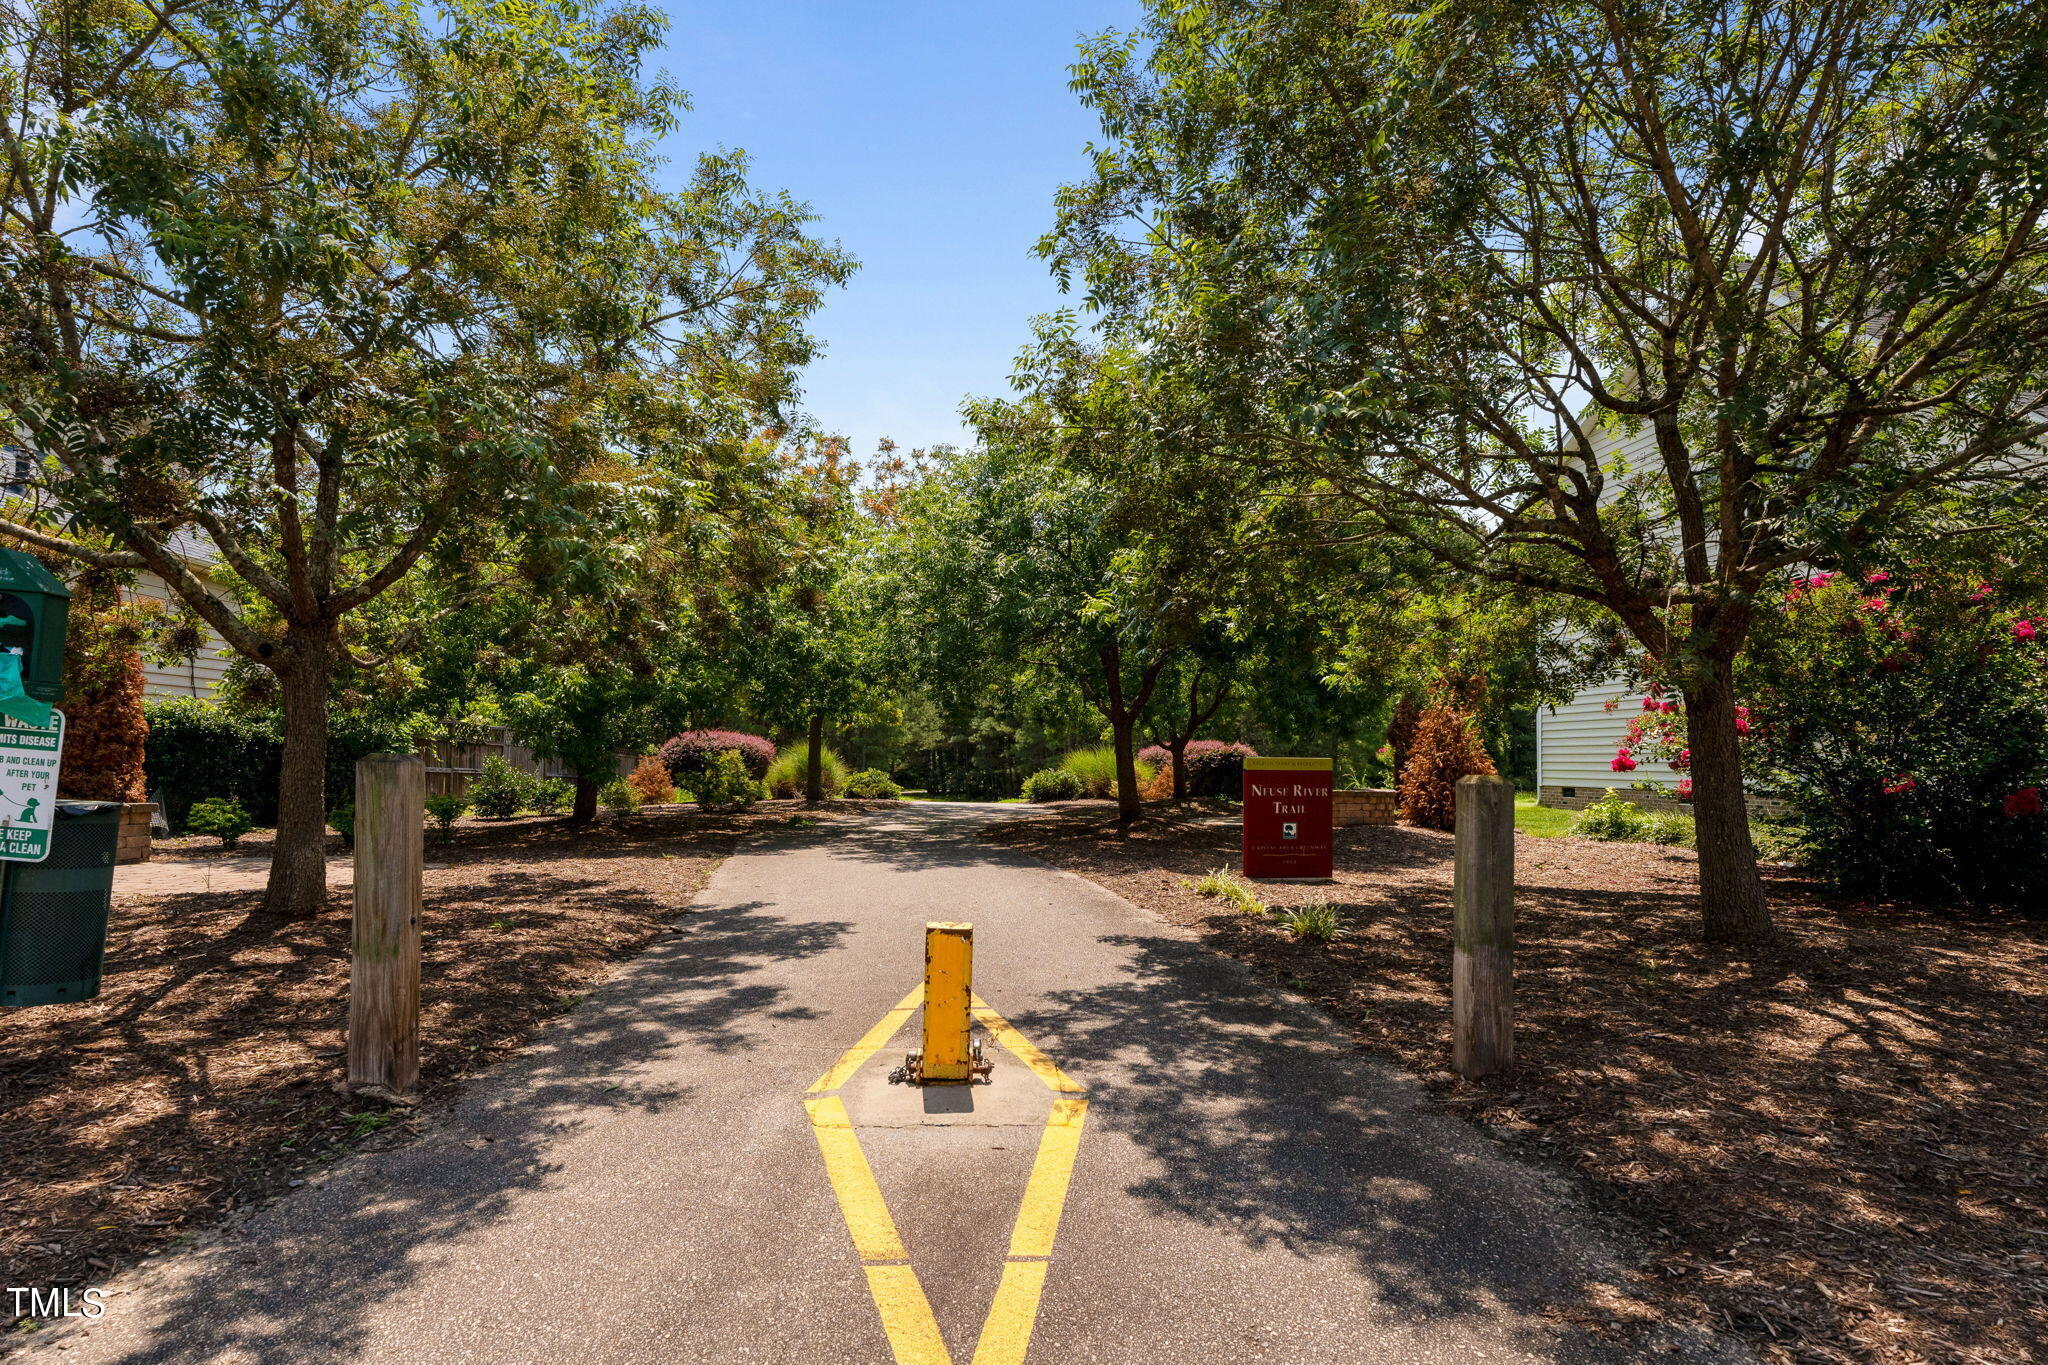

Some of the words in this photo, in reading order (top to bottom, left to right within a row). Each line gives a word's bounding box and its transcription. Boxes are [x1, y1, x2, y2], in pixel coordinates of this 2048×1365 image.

[19, 735, 57, 748] DISEASE
[6, 756, 21, 765] AND
[22, 757, 45, 767] CLEAN
[47, 759, 57, 768] UP
[6, 768, 29, 779] AFTER
[31, 770, 50, 780] YOUR
[21, 782, 37, 792] PET
[1251, 784, 1289, 797] NEUSE
[1293, 784, 1328, 797] RIVER
[1273, 801, 1306, 814] TRAIL
[6, 829, 32, 841] KEEP
[9, 842, 41, 855] CLEAN
